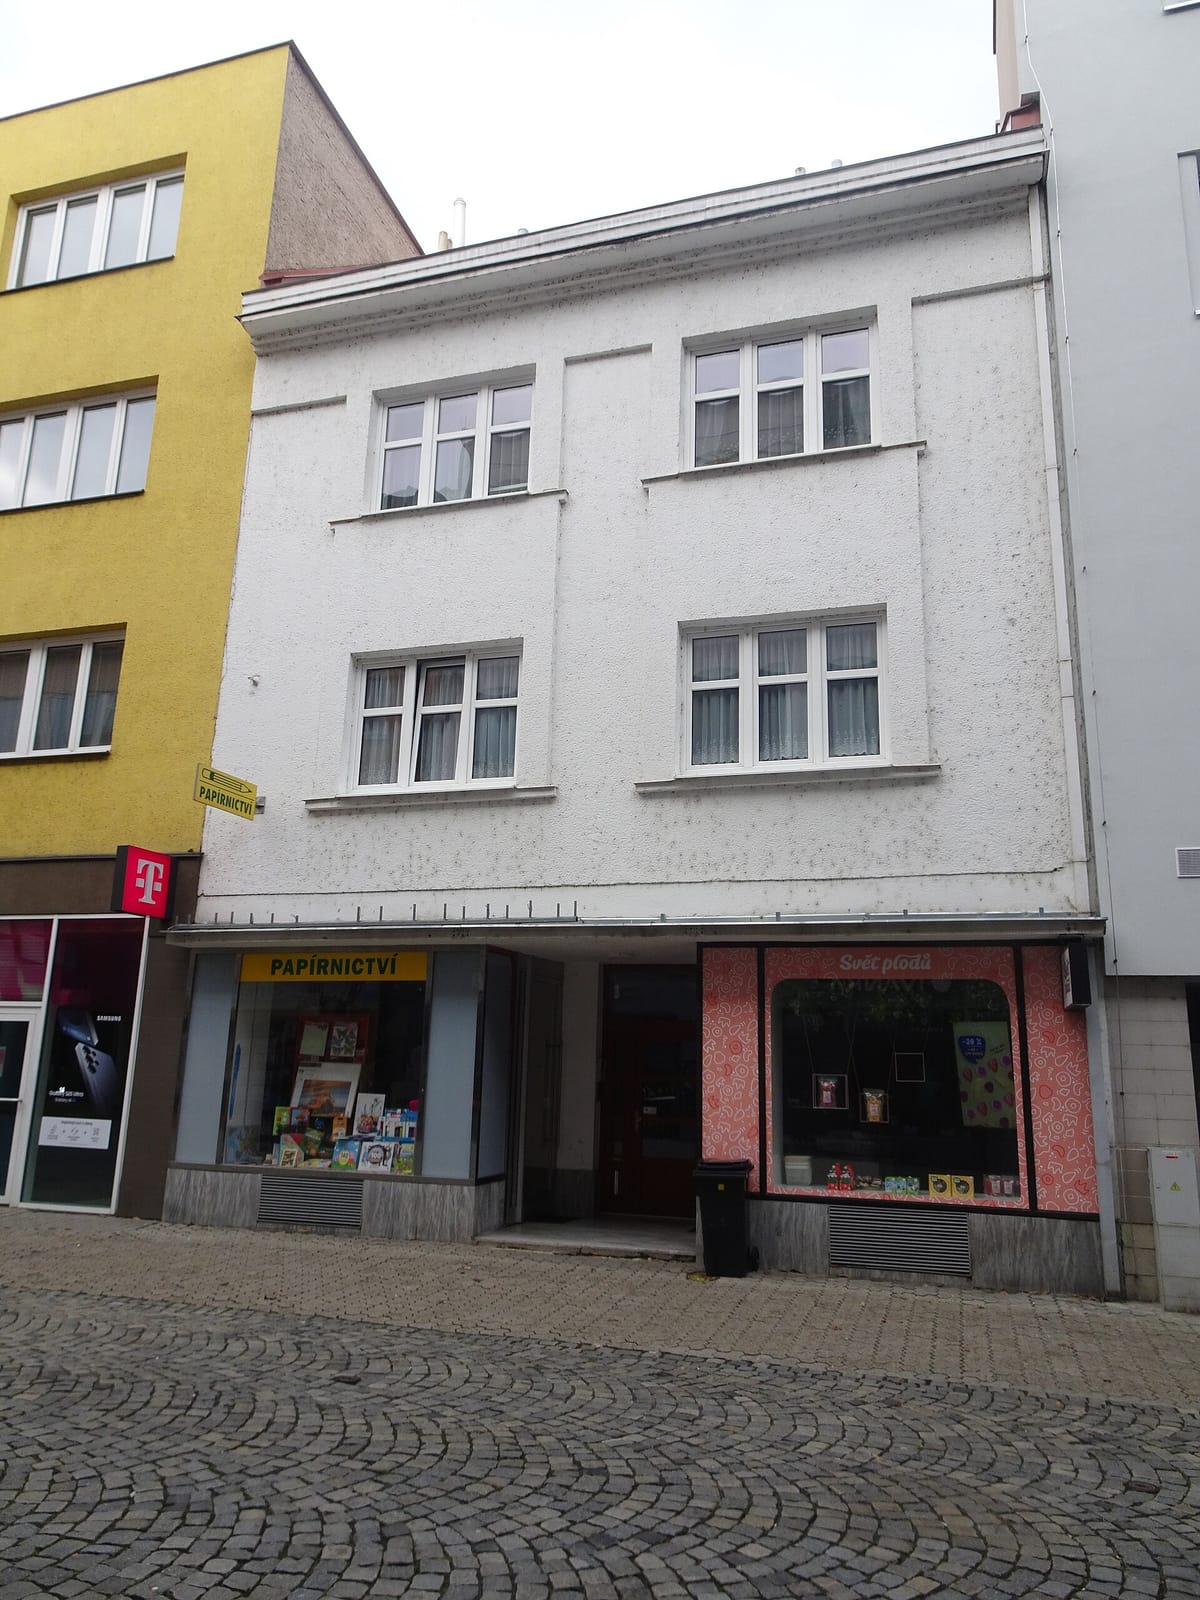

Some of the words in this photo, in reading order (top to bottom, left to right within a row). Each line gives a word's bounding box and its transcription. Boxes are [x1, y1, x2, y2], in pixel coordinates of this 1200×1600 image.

[199, 785, 253, 815] PAPÍRNICTVÍ
[136, 858, 164, 905] T
[270, 952, 398, 976] PAPÍRNICTVÍ
[840, 953, 880, 971] Svět
[881, 952, 932, 976] plodů
